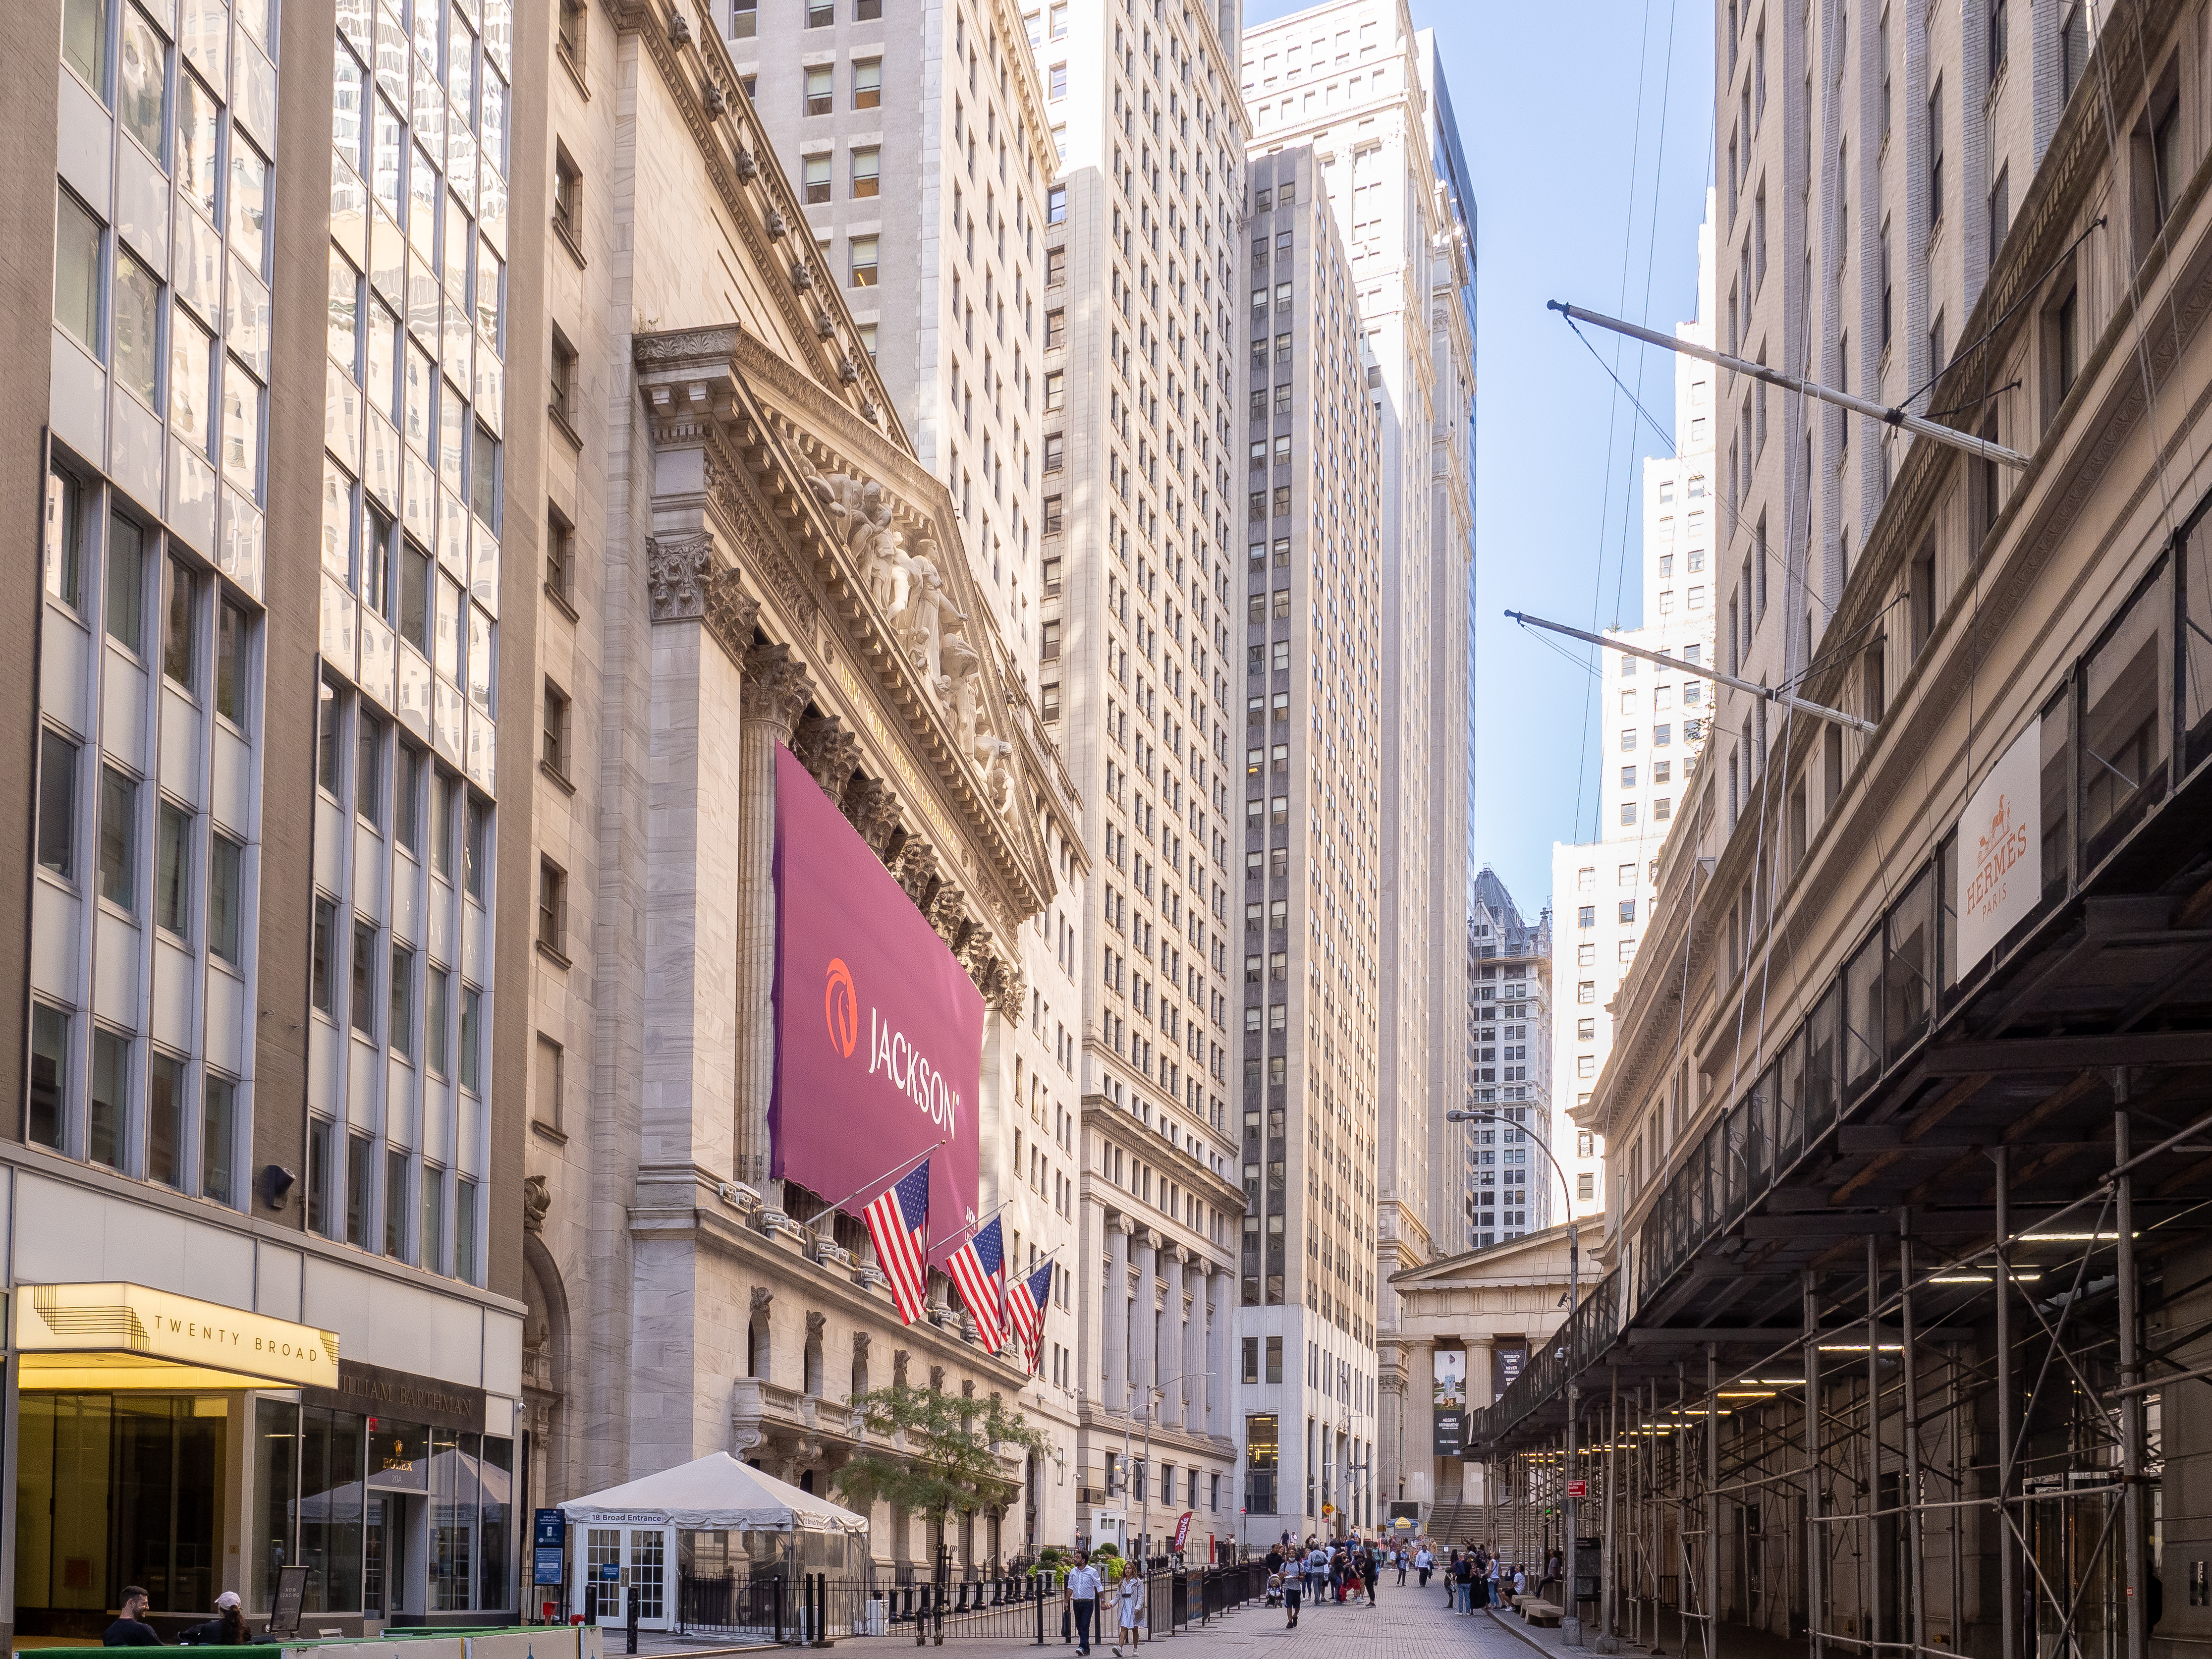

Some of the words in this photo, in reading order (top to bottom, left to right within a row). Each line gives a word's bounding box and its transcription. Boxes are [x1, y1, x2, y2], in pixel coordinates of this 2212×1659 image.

[839, 662, 860, 707] NEW
[863, 700, 889, 752] YORK
[892, 744, 918, 793] STOCK
[920, 785, 958, 854] EXCHANGE
[1982, 883, 2007, 922] PARIS
[869, 1006, 955, 1141] JACKSON
[155, 1315, 240, 1345] TWENTY
[256, 1337, 317, 1362] BROAD
[338, 1375, 392, 1402] ILLIAM
[399, 1385, 471, 1416] BARTHMAN
[383, 1457, 413, 1472] ROLEX
[391, 1475, 402, 1484] 20A
